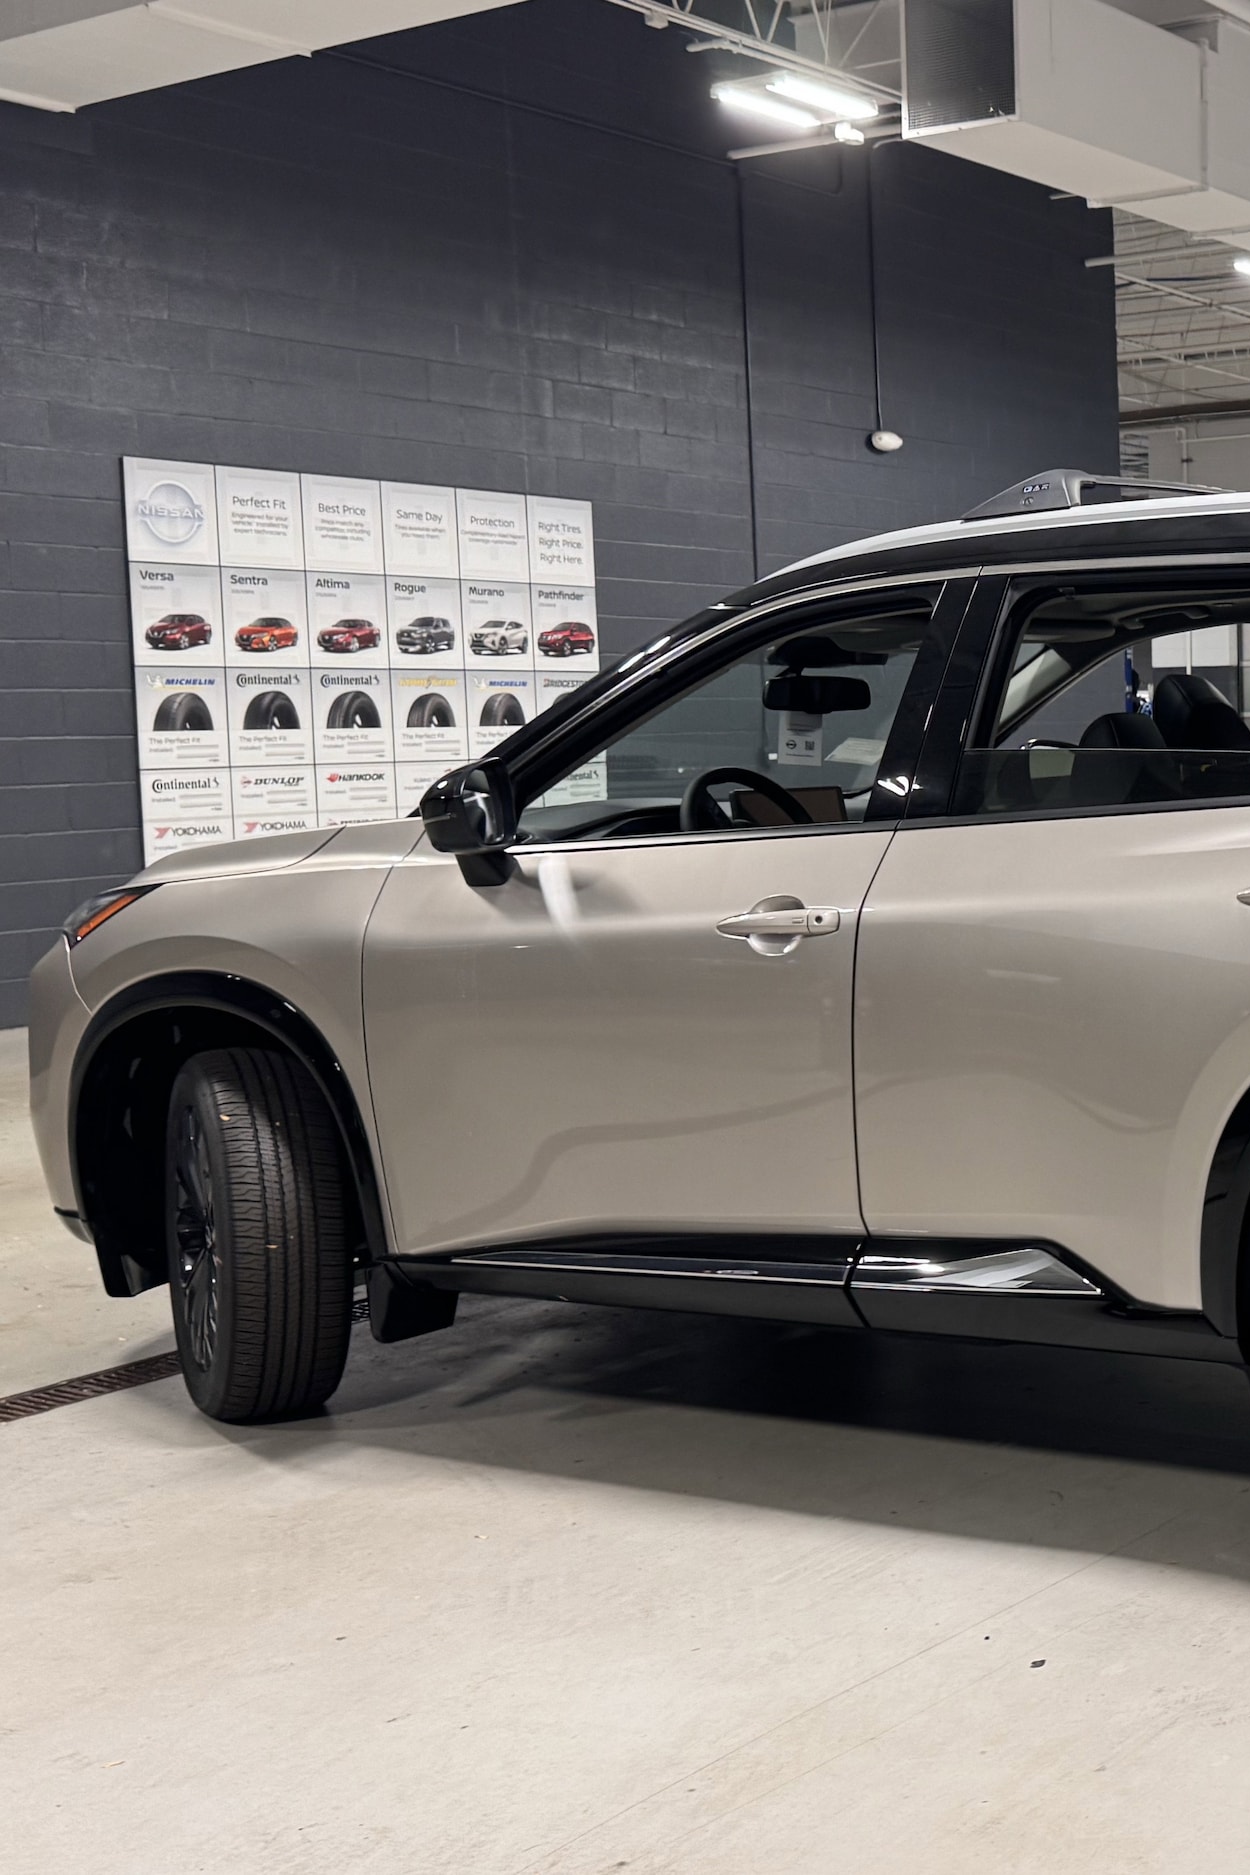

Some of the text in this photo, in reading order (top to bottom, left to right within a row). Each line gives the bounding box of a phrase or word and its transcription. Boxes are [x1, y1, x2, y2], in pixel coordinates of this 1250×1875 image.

[232, 495, 286, 510] Perfect Fit
[318, 502, 366, 516] Best Price
[137, 502, 205, 521] NISSAN
[396, 509, 443, 524] Same Day
[470, 515, 515, 529] Protection
[538, 522, 560, 535] Right
[538, 537, 561, 550] Right
[539, 553, 562, 567] Right
[139, 569, 174, 582] Versa
[230, 574, 268, 586] Sentra
[315, 577, 350, 590] Altima
[394, 582, 426, 595] Rogue
[468, 586, 505, 597] Murano
[538, 589, 584, 601] Pathfinder
[165, 678, 216, 686] MICHELIN
[236, 673, 292, 687] Continental
[320, 673, 373, 687] Continental
[543, 678, 585, 688] BRIDGEST
[152, 778, 211, 793] Continental
[254, 776, 305, 786] DUNLOP
[171, 826, 222, 836] YOKOHAMA
[260, 820, 306, 830] YOKOHAMA
